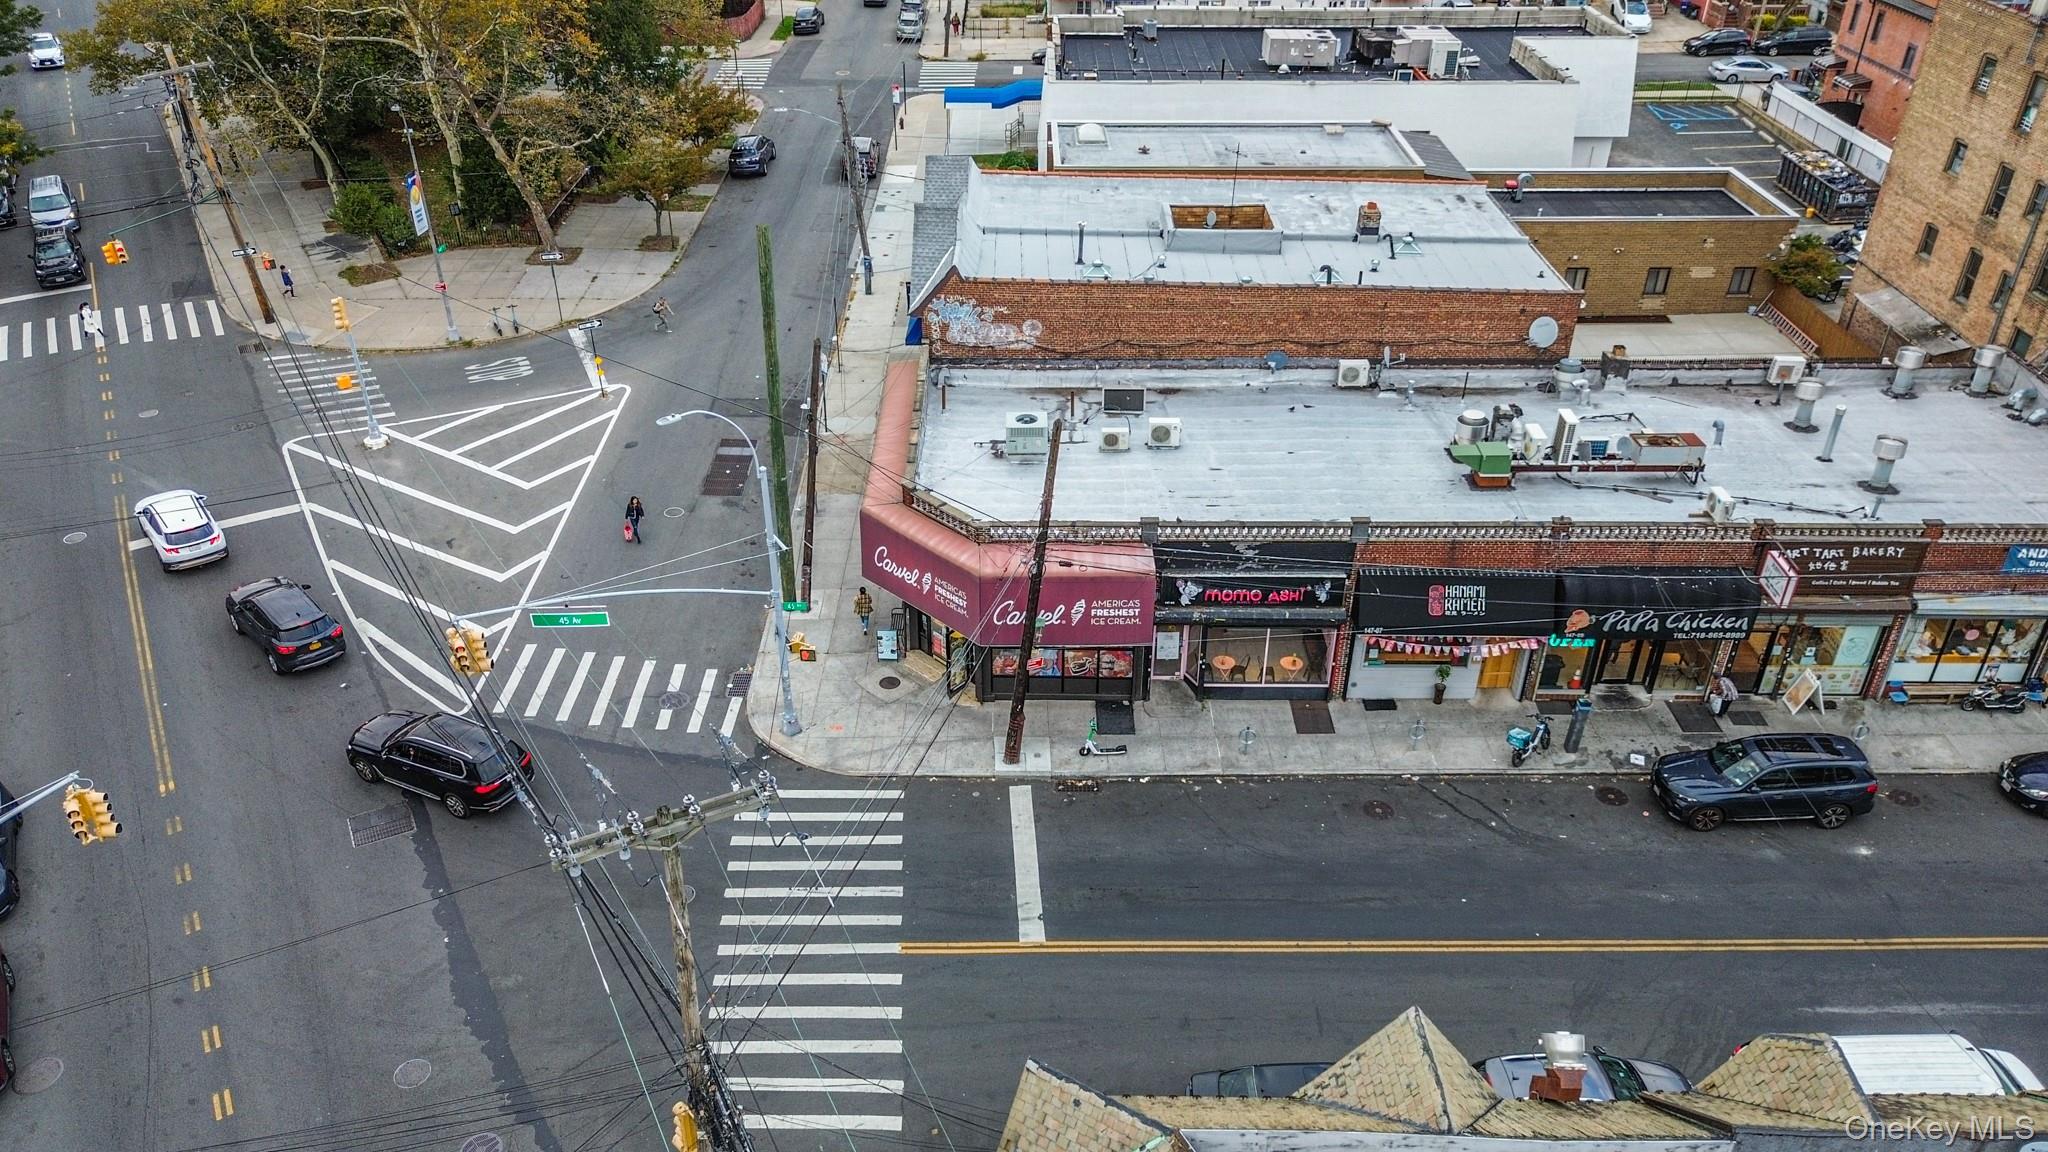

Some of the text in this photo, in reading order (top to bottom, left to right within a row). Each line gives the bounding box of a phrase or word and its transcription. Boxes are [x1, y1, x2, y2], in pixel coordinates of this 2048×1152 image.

[1813, 547, 1845, 560] TART
[1852, 547, 1905, 558] BAKERY
[875, 546, 917, 587] Carvel
[934, 585, 968, 609] FRESHEST
[1445, 585, 1486, 598] HANAMI
[935, 594, 944, 604] ICE
[1091, 600, 1141, 608] AMERICA'S
[1445, 598, 1486, 611] RAMEN
[1091, 608, 1141, 617] FRESHEST
[559, 616, 582, 625] 45 Av
[1665, 612, 1749, 631] Chicken
